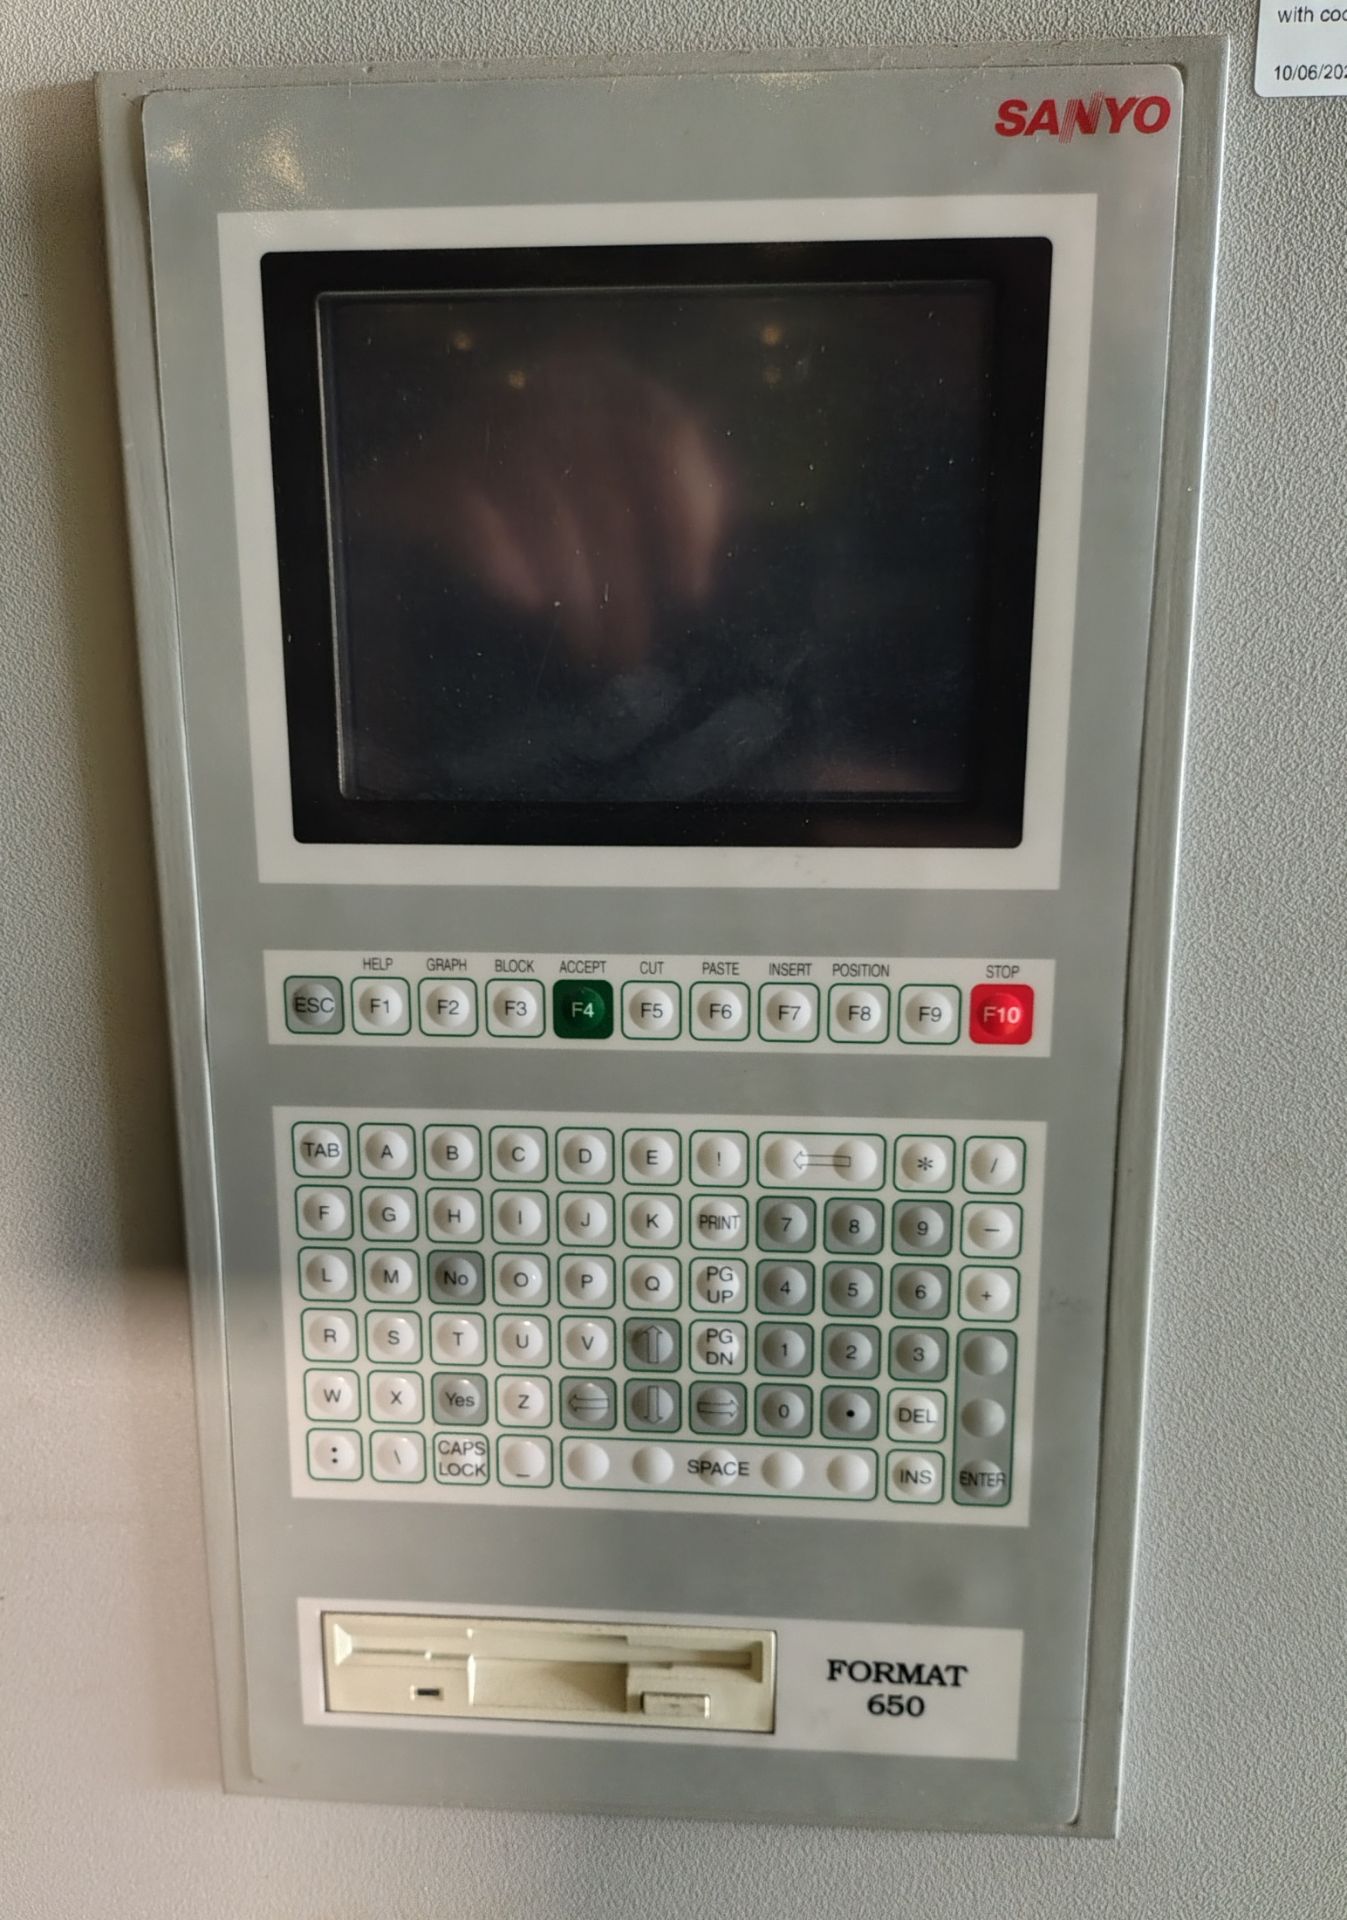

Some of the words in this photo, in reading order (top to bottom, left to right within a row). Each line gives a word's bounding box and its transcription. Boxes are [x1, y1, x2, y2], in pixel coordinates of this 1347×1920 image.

[1278, 6, 1314, 23] with
[995, 92, 1171, 143] SANYO
[363, 958, 393, 972] HELP
[426, 958, 467, 972] GRAPH
[494, 959, 534, 973] BLOCK
[559, 960, 607, 974] ACCEPT
[639, 961, 664, 975] CUT
[702, 962, 740, 975] PASTE
[768, 963, 812, 976] INSERT
[832, 964, 890, 977] POSITION
[985, 965, 1020, 979] STOP
[294, 997, 335, 1014] ESC
[369, 998, 391, 1014] F1
[437, 999, 460, 1015] F2
[505, 1000, 527, 1016] F3
[571, 1002, 595, 1018] F4
[640, 1002, 663, 1019] F5
[709, 1003, 733, 1019] F6
[778, 1005, 801, 1021] F7
[848, 1005, 872, 1022] F8
[918, 1006, 942, 1022] F9
[983, 1007, 1021, 1023] F10
[303, 1142, 340, 1158] TAB
[380, 1144, 394, 1159] A
[446, 1145, 459, 1161] B
[511, 1147, 526, 1162] C
[578, 1148, 592, 1164] D
[646, 1149, 659, 1165] E
[717, 1151, 721, 1167] !
[990, 1157, 998, 1174] /
[319, 1206, 330, 1220] F
[381, 1207, 397, 1222] G
[448, 1209, 461, 1223] H
[517, 1210, 522, 1225] I
[580, 1212, 590, 1227] J
[646, 1213, 659, 1229] K
[699, 1214, 741, 1230] PRINT
[781, 1217, 793, 1232] 7
[848, 1219, 860, 1234] 8
[917, 1221, 929, 1236] 9
[321, 1268, 332, 1283] L
[383, 1269, 399, 1284] M
[443, 1271, 469, 1287] No
[513, 1272, 529, 1288] O
[706, 1265, 733, 1282] PG
[581, 1274, 593, 1289] P
[644, 1275, 660, 1292] Q
[780, 1280, 790, 1295] 4
[706, 1290, 734, 1304] UP
[847, 1282, 859, 1297] 5
[915, 1284, 926, 1300] 6
[981, 1290, 992, 1301] +
[324, 1328, 337, 1343] R
[387, 1330, 400, 1345] S
[452, 1332, 465, 1346] T
[516, 1334, 530, 1349] U
[580, 1335, 595, 1351] V
[706, 1328, 733, 1345] PG
[781, 1344, 787, 1357] 1
[845, 1345, 858, 1360] 2
[912, 1346, 925, 1362] 3
[706, 1351, 734, 1366] DN
[323, 1388, 342, 1403] W
[390, 1390, 403, 1405] X
[444, 1392, 475, 1408] Yes
[518, 1394, 530, 1409] Z
[899, 1407, 937, 1424] DEL
[437, 1440, 486, 1456] CAPS
[438, 1462, 487, 1478] LOCK
[687, 1459, 750, 1477] SPACE
[900, 1469, 932, 1484] INS
[959, 1470, 1006, 1488] ENTER
[826, 1658, 969, 1687] FORMAT
[867, 1693, 925, 1718] 650
